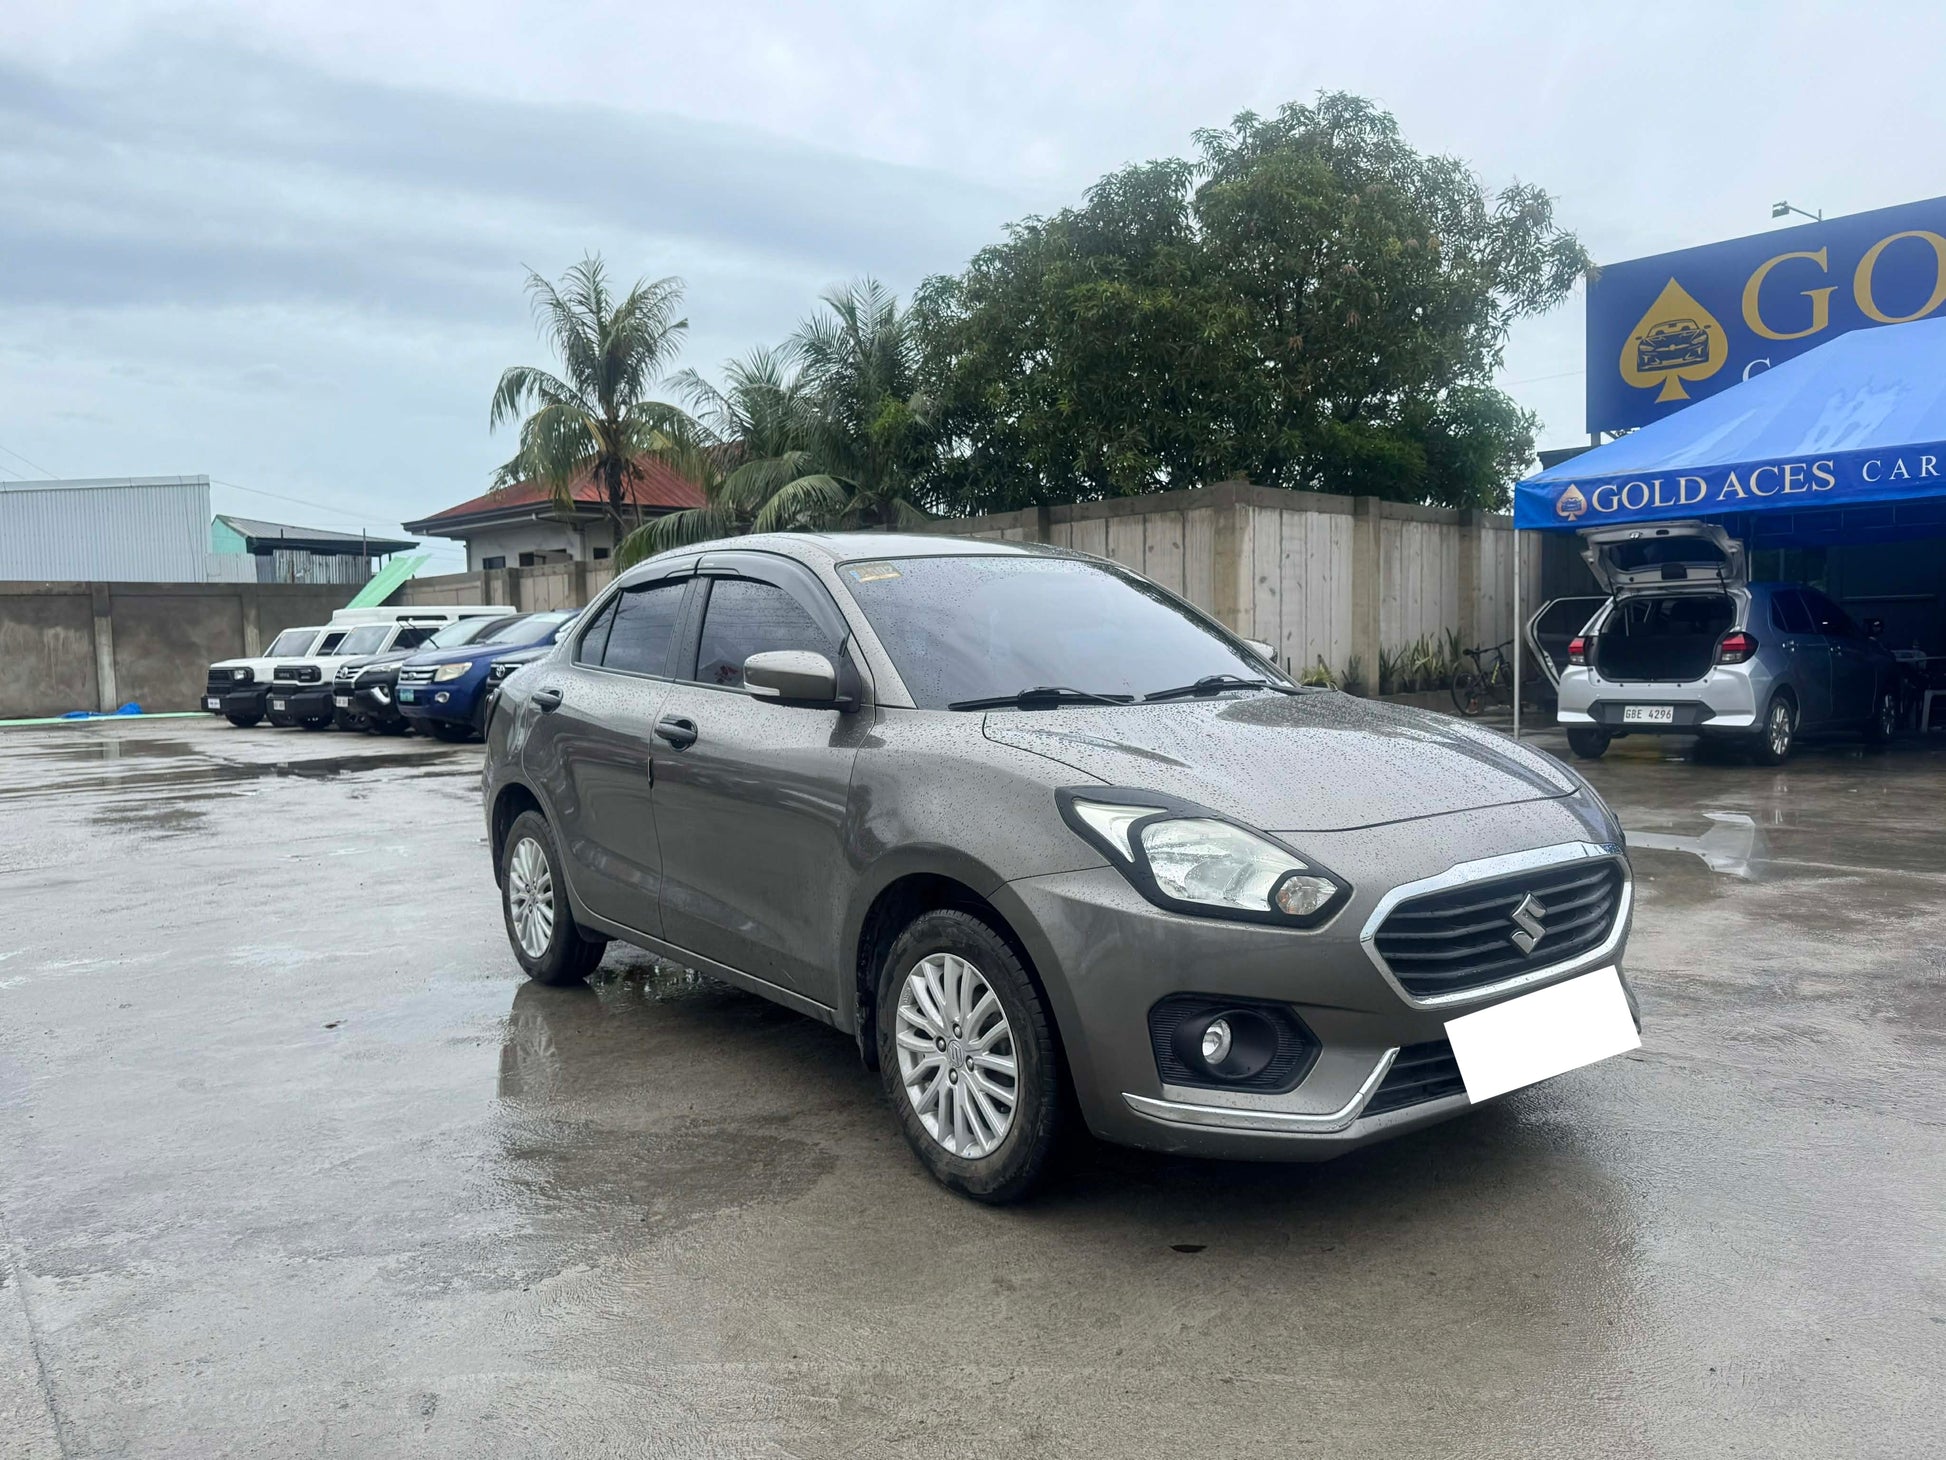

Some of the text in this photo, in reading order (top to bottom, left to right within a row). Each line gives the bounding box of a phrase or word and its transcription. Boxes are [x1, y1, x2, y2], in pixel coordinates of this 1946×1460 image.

[1742, 230, 1946, 340] GO
[1592, 455, 1941, 513] GOLD ACES CAR
[1625, 709, 1672, 720] GBE 4296
